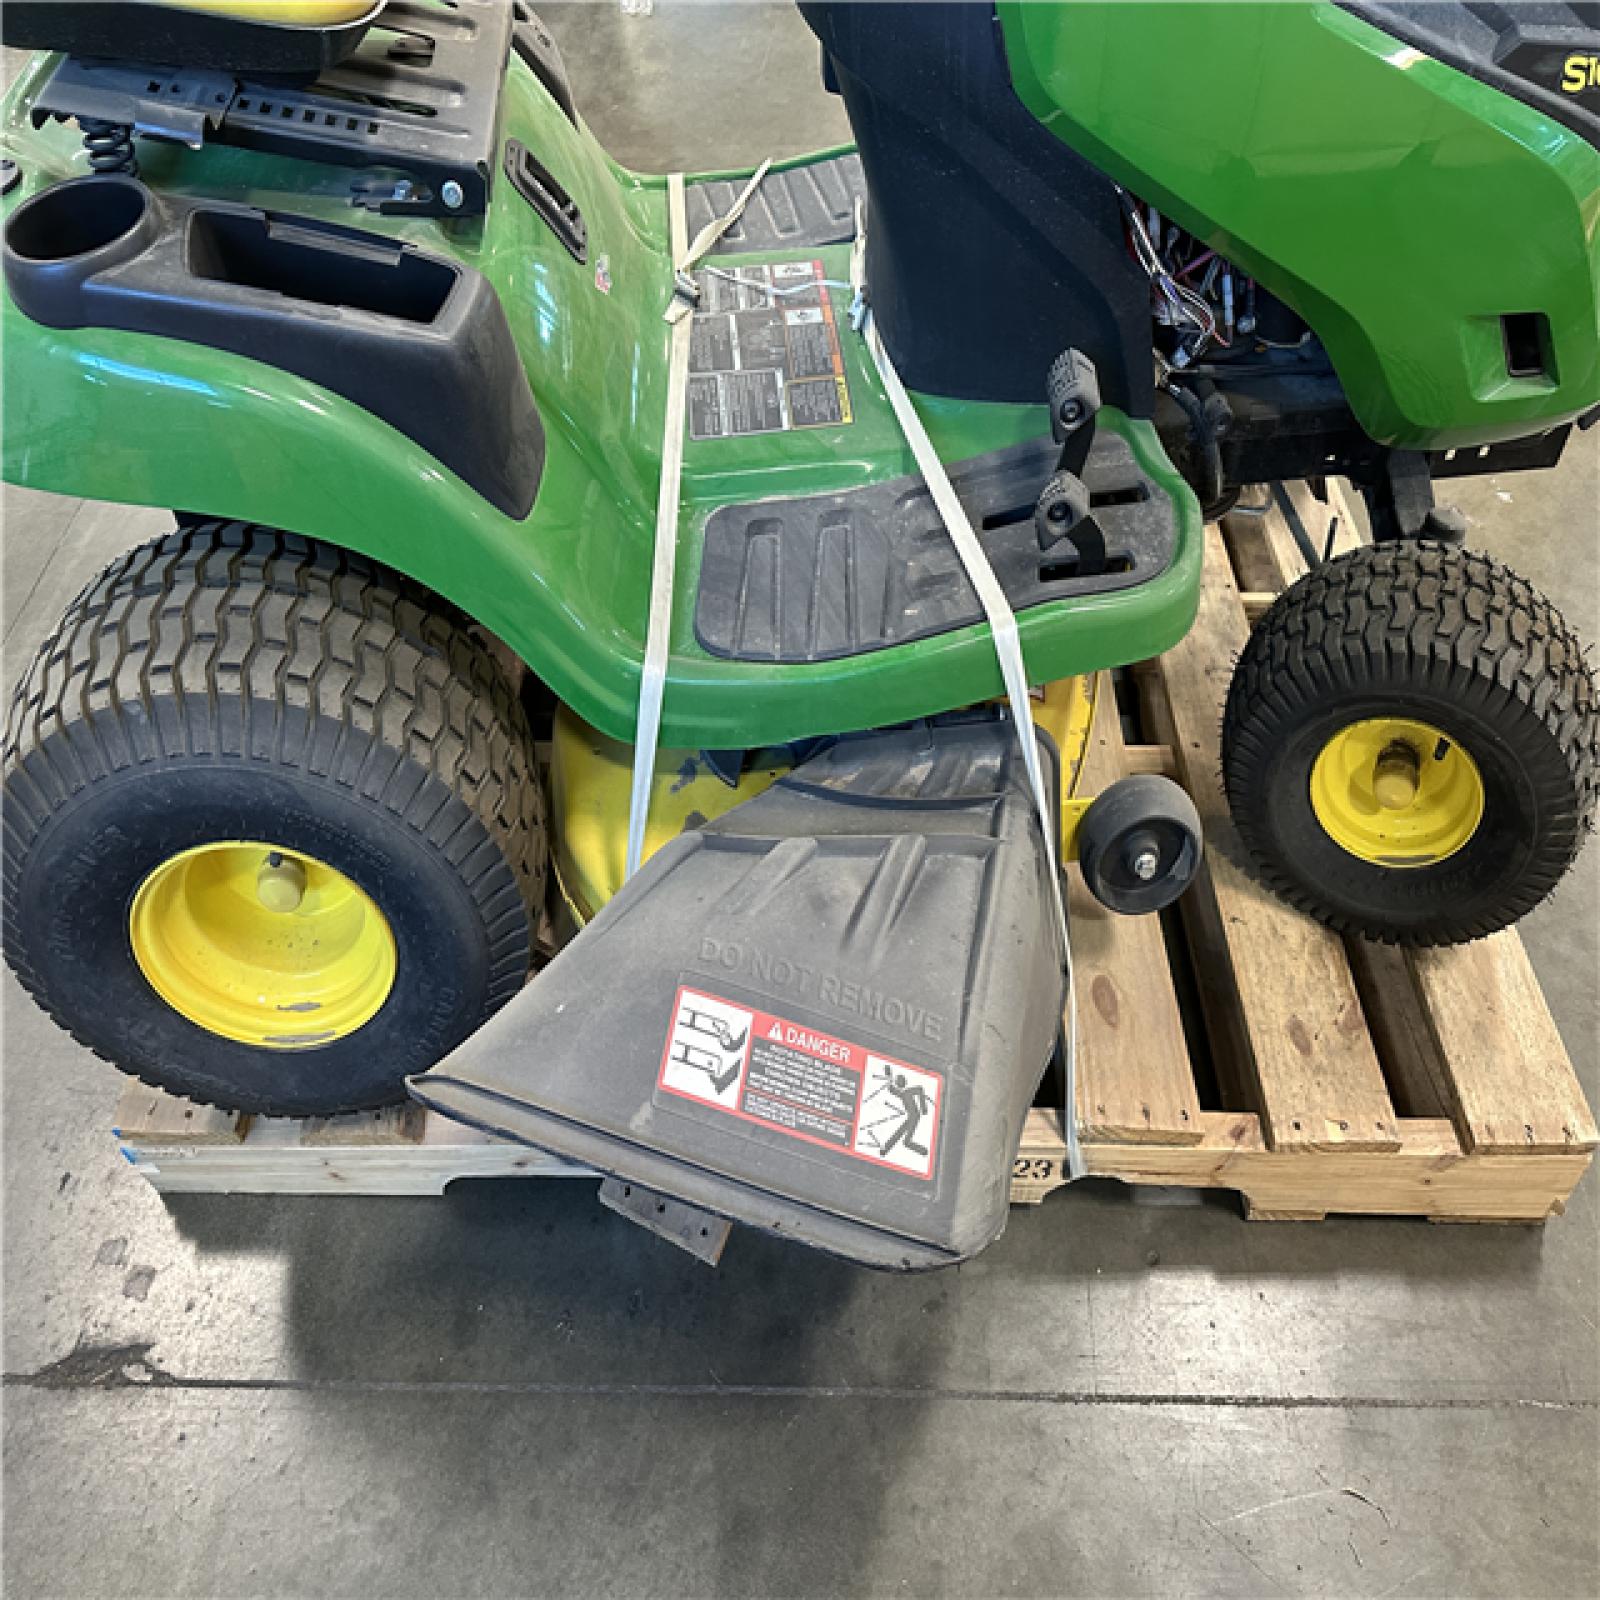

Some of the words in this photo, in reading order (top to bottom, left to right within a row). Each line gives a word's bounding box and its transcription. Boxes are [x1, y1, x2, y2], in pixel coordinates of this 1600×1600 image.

[697, 936, 743, 971] DO
[750, 947, 814, 994] NOT
[817, 973, 949, 1042] REMOVE
[785, 1027, 851, 1063] DANGER
[1012, 1159, 1053, 1180] 23
